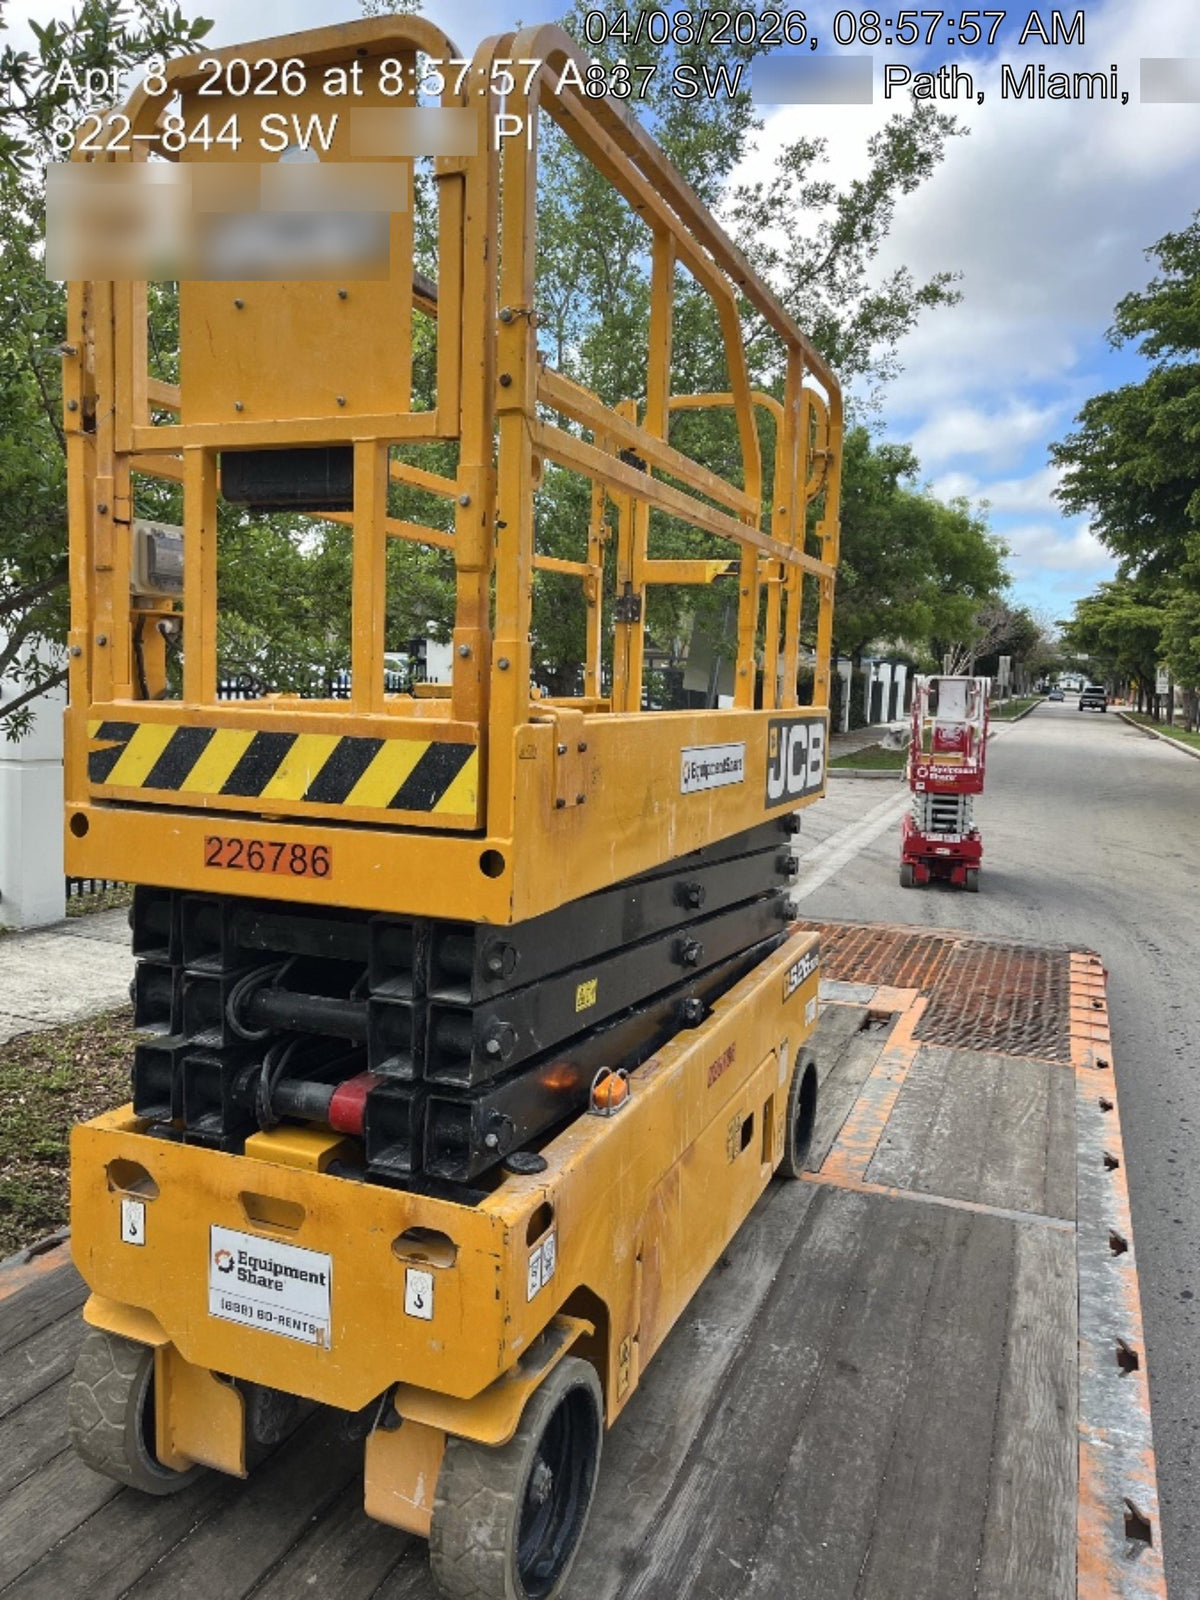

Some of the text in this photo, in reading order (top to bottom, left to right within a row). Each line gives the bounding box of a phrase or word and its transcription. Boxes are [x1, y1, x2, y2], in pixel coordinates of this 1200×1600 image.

[767, 722, 826, 800] JCB
[207, 836, 330, 877] 226786
[237, 1250, 326, 1286] Equipment
[237, 1267, 284, 1291] Share
[220, 1298, 254, 1318] (888)
